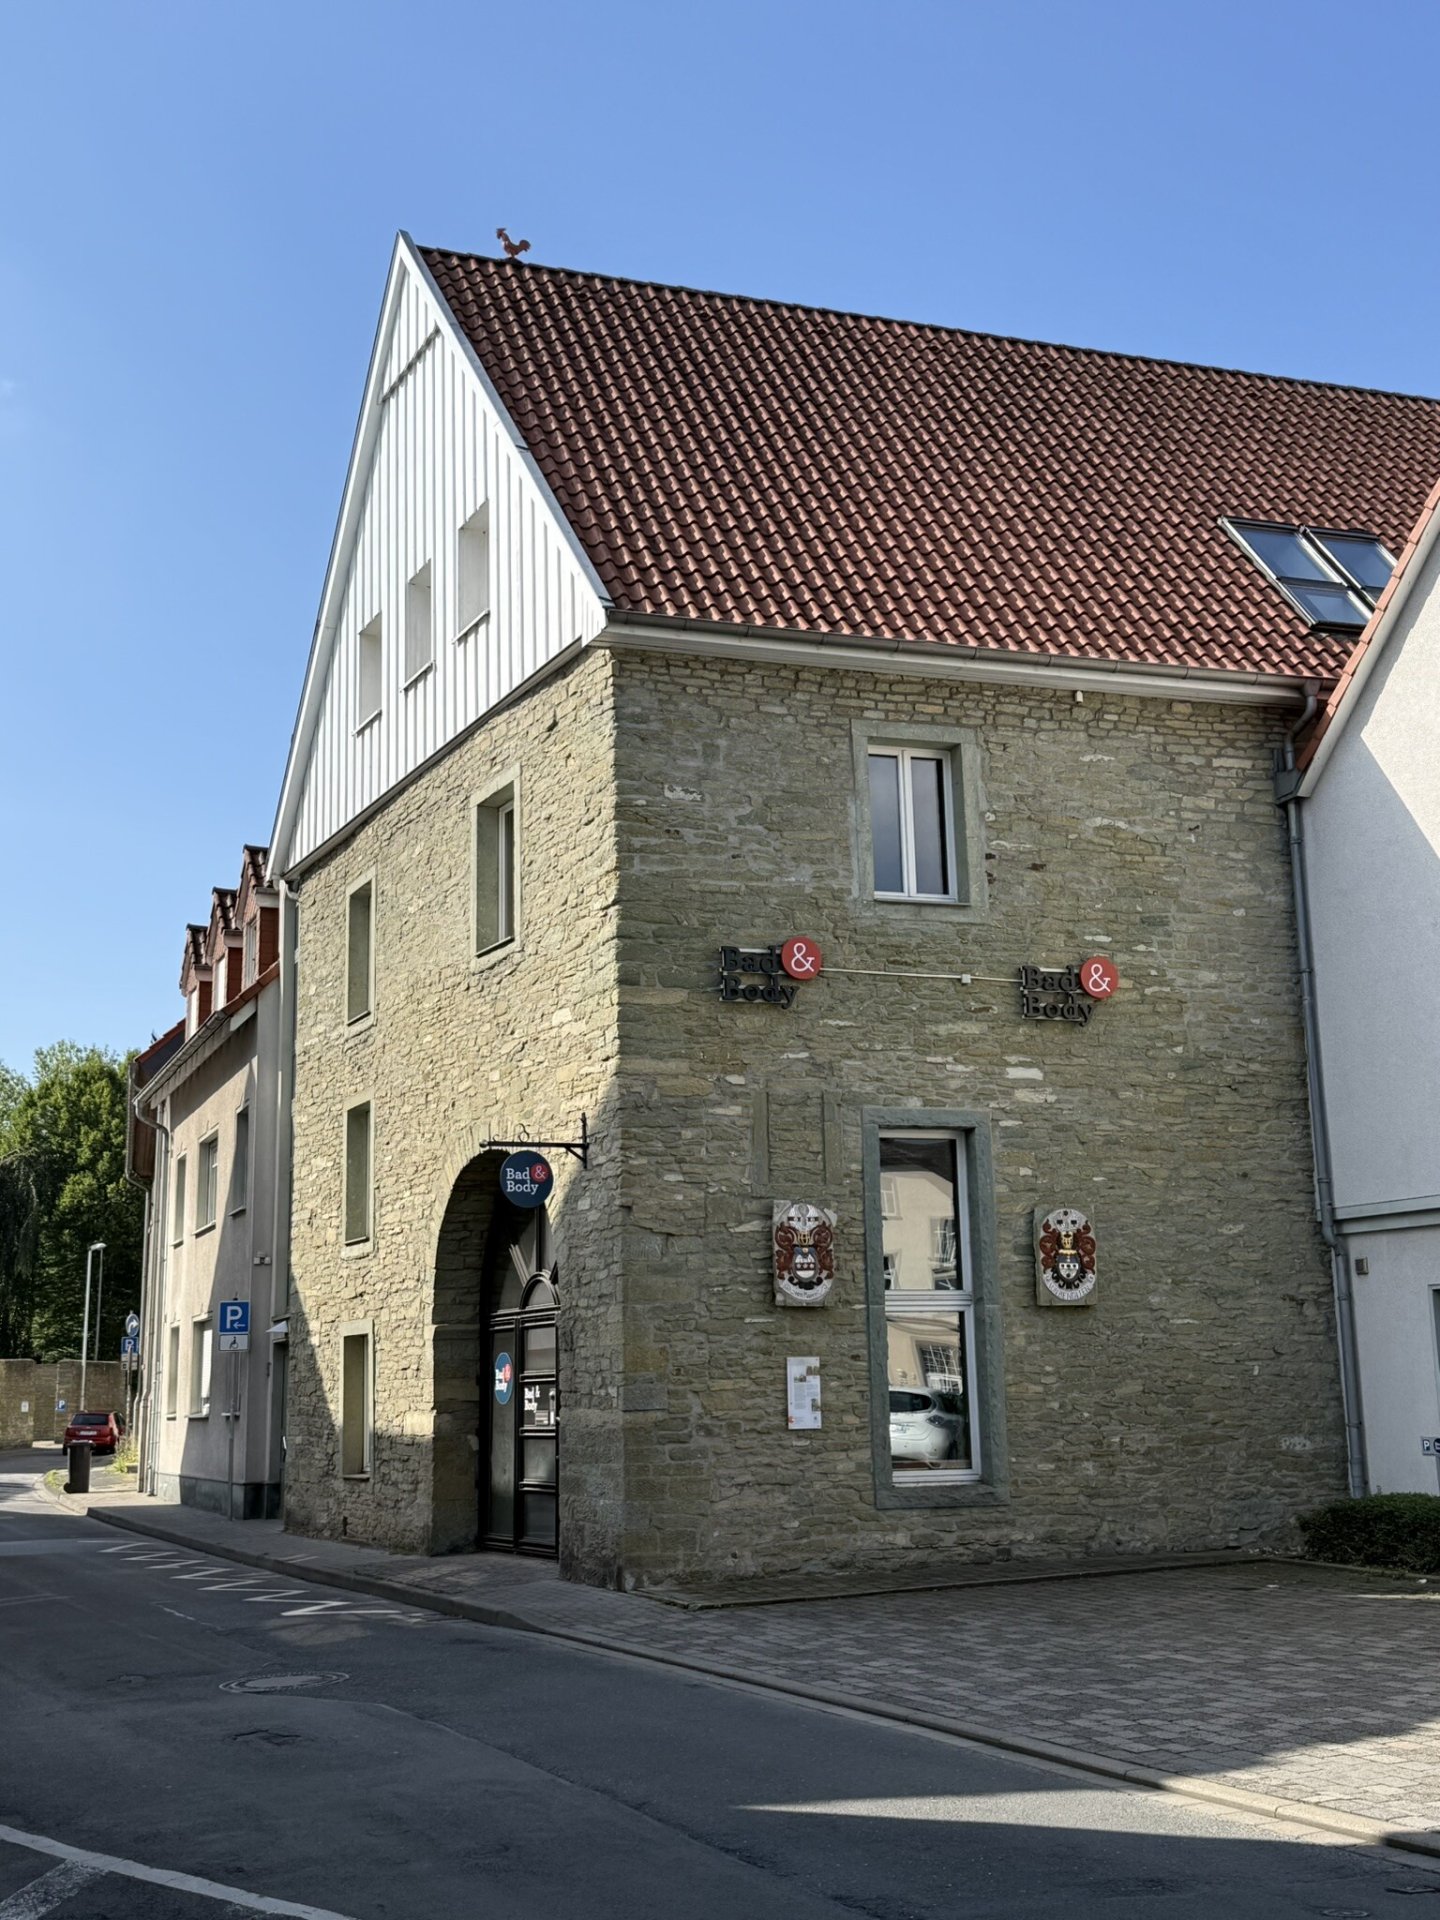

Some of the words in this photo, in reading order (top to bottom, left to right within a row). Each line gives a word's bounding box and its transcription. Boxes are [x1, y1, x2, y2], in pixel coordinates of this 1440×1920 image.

[721, 946, 780, 973] Bad
[791, 943, 815, 972] &
[1022, 965, 1080, 991] Bad
[1089, 964, 1111, 992] &
[722, 975, 800, 1009] Body
[1024, 992, 1093, 1027] Body
[506, 1168, 530, 1180] Bad
[534, 1165, 546, 1179] &
[506, 1180, 539, 1195] Body
[226, 1306, 243, 1329] P
[125, 1339, 134, 1350] P
[58, 1400, 65, 1409] P
[1423, 1440, 1430, 1450] P
